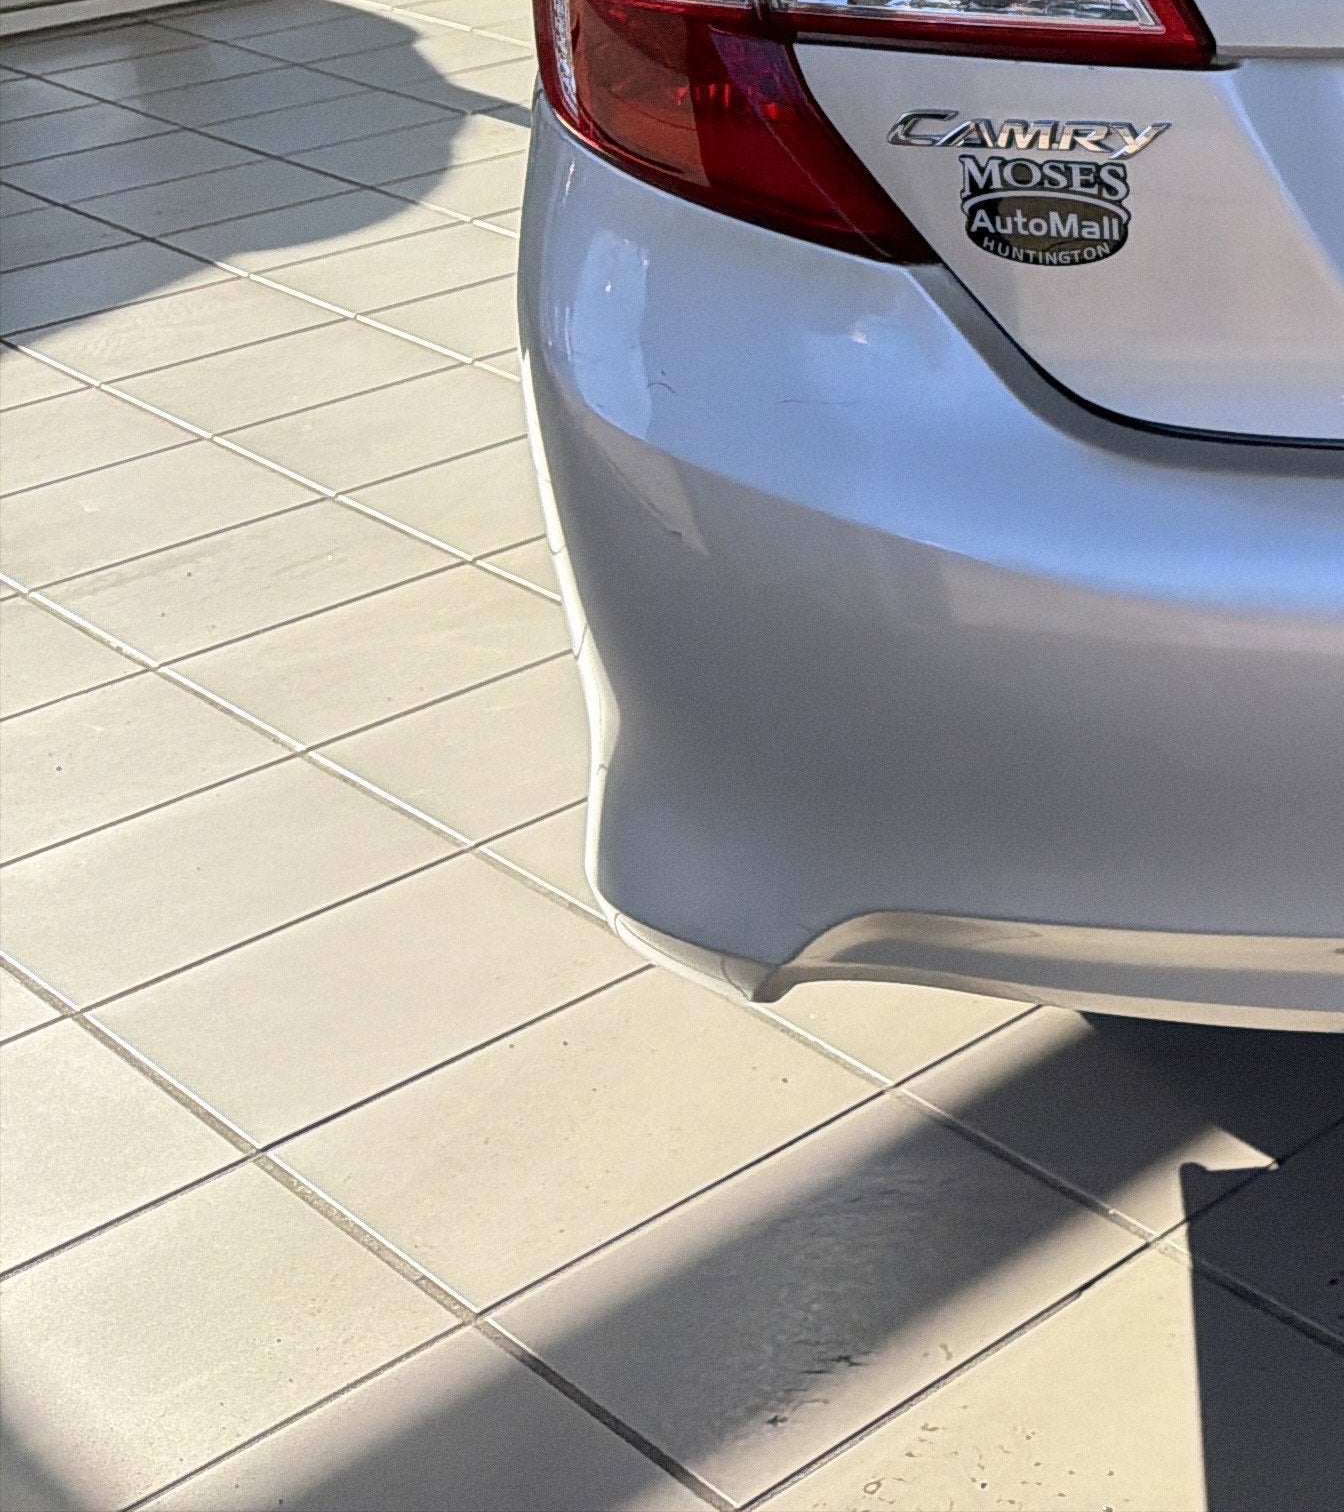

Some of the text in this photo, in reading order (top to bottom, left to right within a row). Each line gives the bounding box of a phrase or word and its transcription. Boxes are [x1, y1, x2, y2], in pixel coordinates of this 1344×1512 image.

[886, 108, 1173, 160] CAMRY
[960, 155, 1131, 201] MOSES
[970, 209, 1121, 240] AutoMall
[982, 237, 1111, 266] HUNTINGTON
